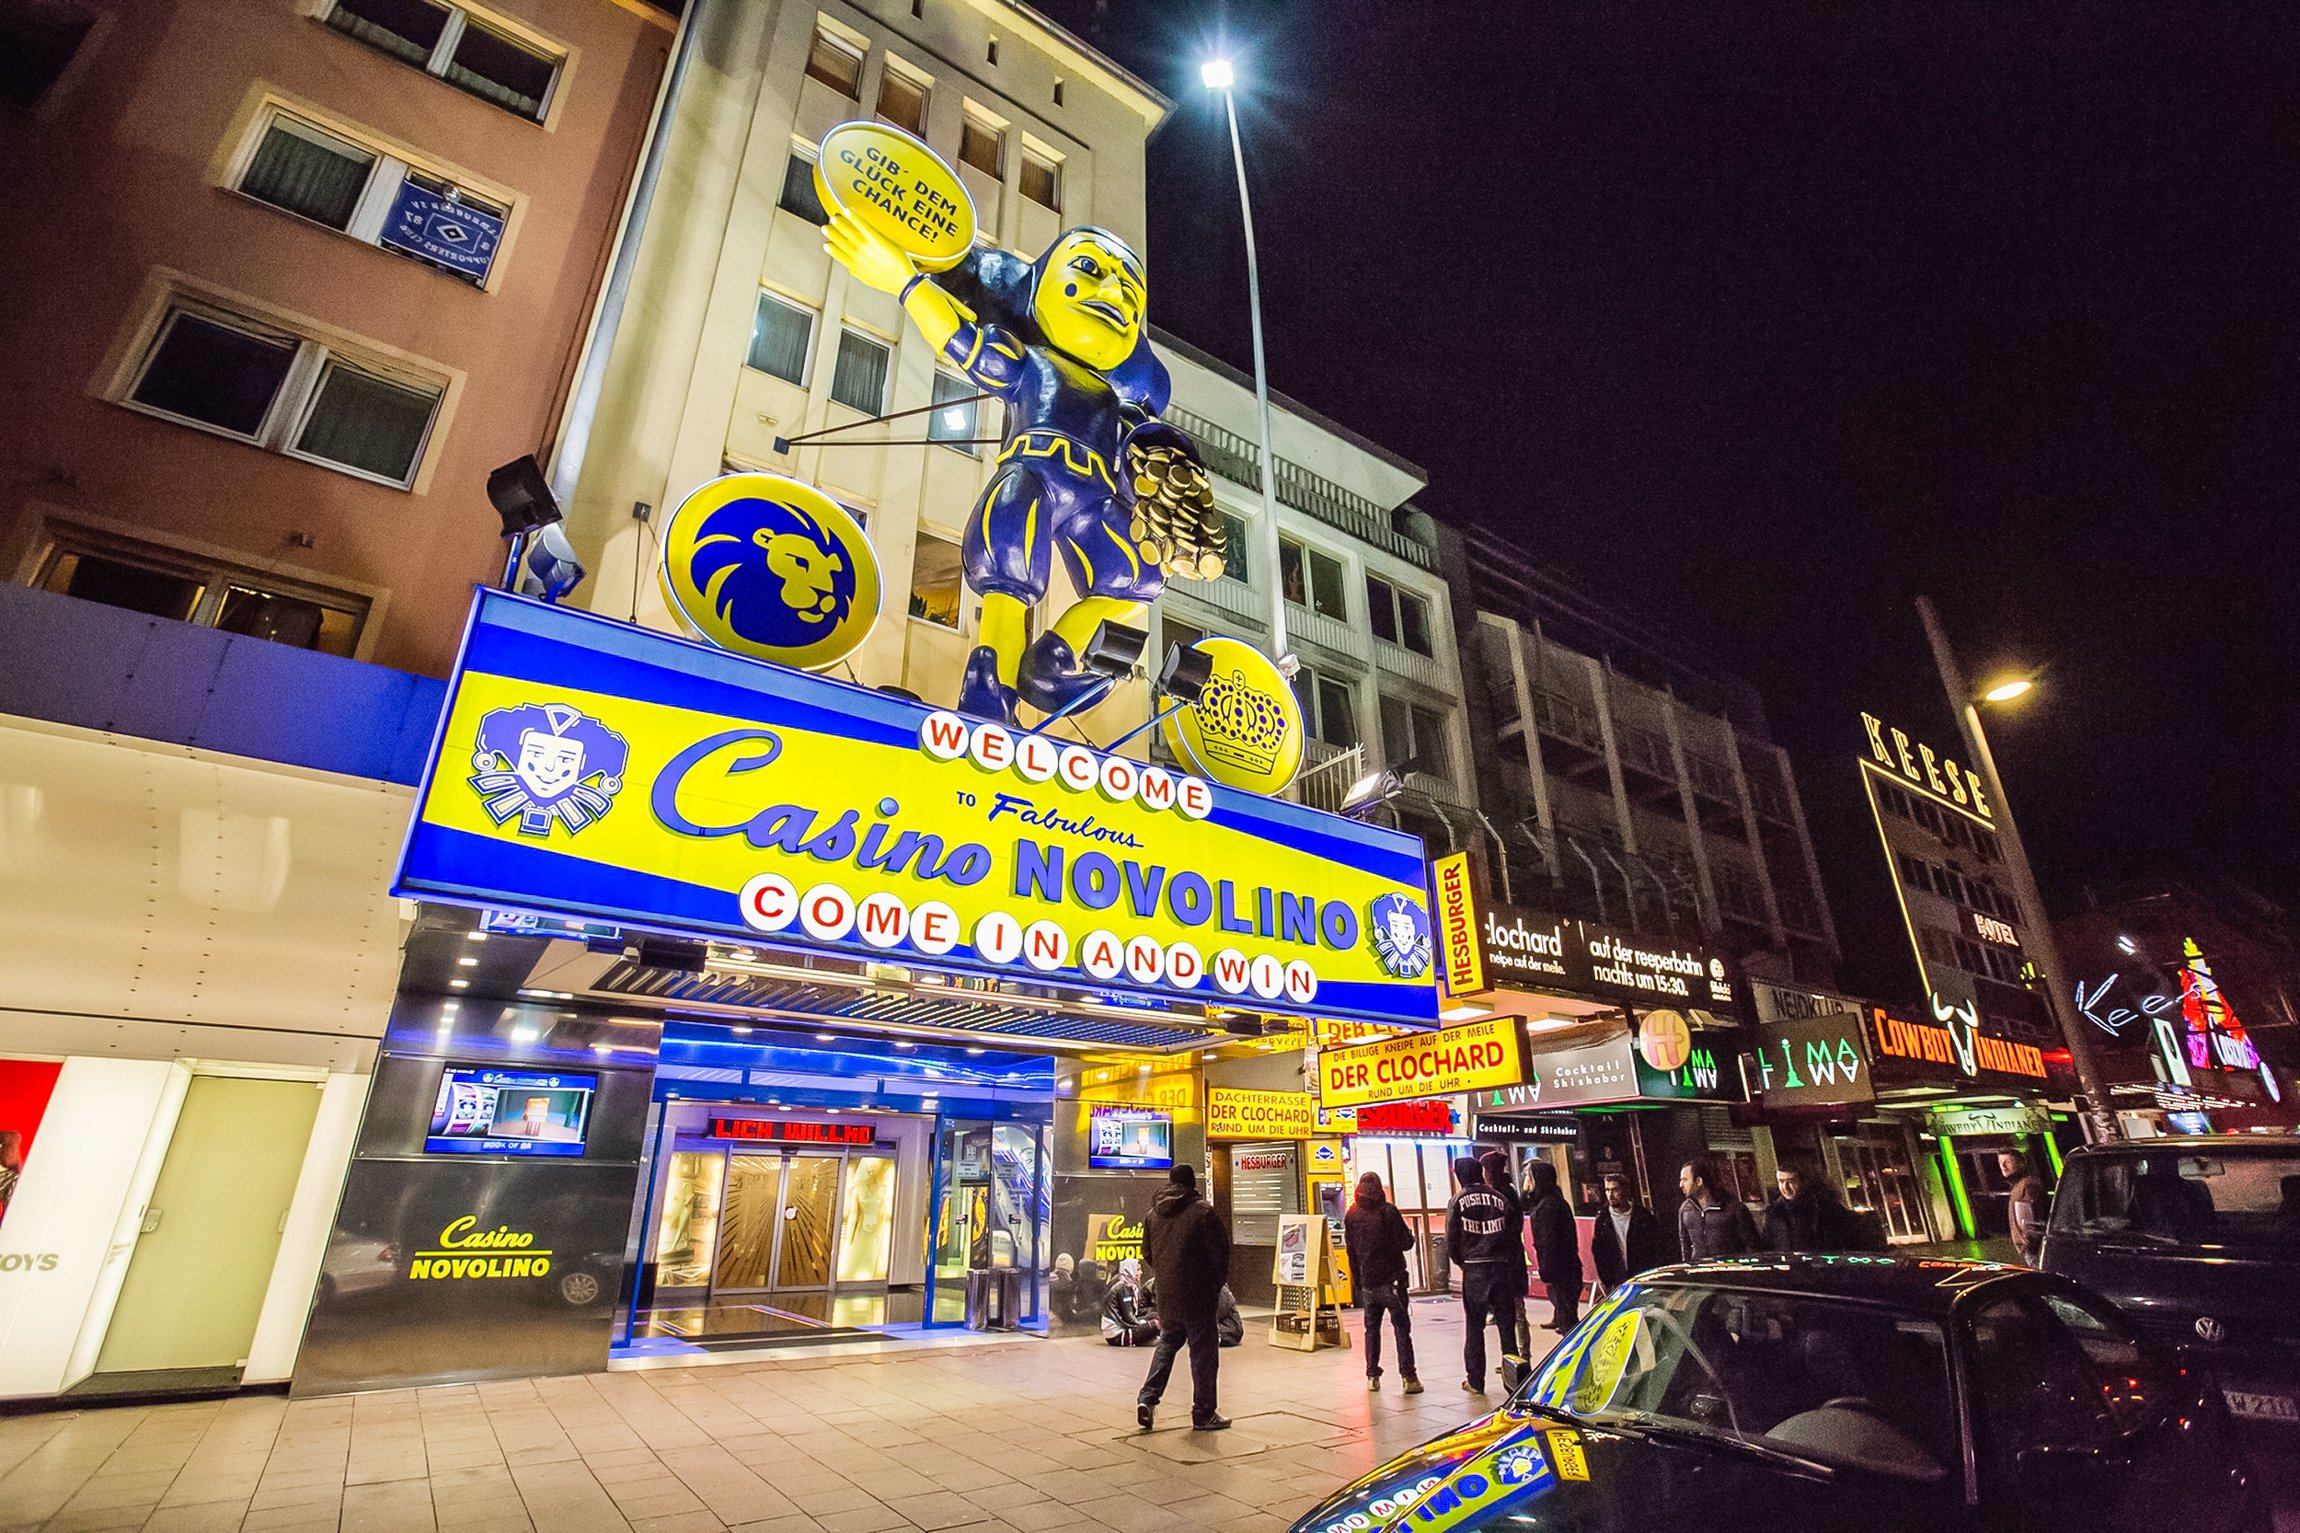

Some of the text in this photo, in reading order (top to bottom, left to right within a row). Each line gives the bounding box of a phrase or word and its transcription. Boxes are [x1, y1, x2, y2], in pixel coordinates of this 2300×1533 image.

[839, 149, 959, 237] GLÜCK EINE
[914, 180, 958, 216] DEM
[852, 179, 939, 243] CHANCE!
[929, 717, 1206, 811] WELCOME
[1860, 711, 1993, 819] KEESE
[956, 791, 1145, 848] TO Fabulous
[651, 728, 1360, 952] Casino NOVOLINO
[1443, 862, 1475, 987] HESBURGER
[1485, 911, 1563, 957] lochard
[753, 885, 1310, 994] COME IN AND WIN
[1488, 950, 1513, 968] neipe
[1590, 935, 1704, 977] auf der reeperbahn
[1593, 961, 1635, 987] nachts
[1635, 973, 1655, 990] um
[1334, 1024, 1495, 1062] DIE BILLIGE KNEIPE AUF DER MEILE
[1331, 1041, 1504, 1090] DER CLOCHARD
[1555, 1060, 1620, 1077] Cocktail
[1368, 1078, 1461, 1099] RUND UM DIE UHR
[1553, 1073, 1625, 1089] Shishabar
[1215, 1091, 1307, 1106] DACHTERRASSE
[1211, 1104, 1309, 1123] DER CLOCHARD
[1211, 1122, 1309, 1136] RUND UM DIE UHR
[1524, 1125, 1537, 1134] und
[1241, 1153, 1288, 1170] HESBURGER
[1459, 1193, 1505, 1211] PUSH IT TO
[439, 1213, 534, 1249] Casino
[1106, 1214, 1144, 1239] Casi
[1461, 1216, 1481, 1234] THE
[0, 1253, 59, 1272] OYS
[1096, 1246, 1144, 1261] NOVOL
[409, 1257, 551, 1280] NOVOLINO
